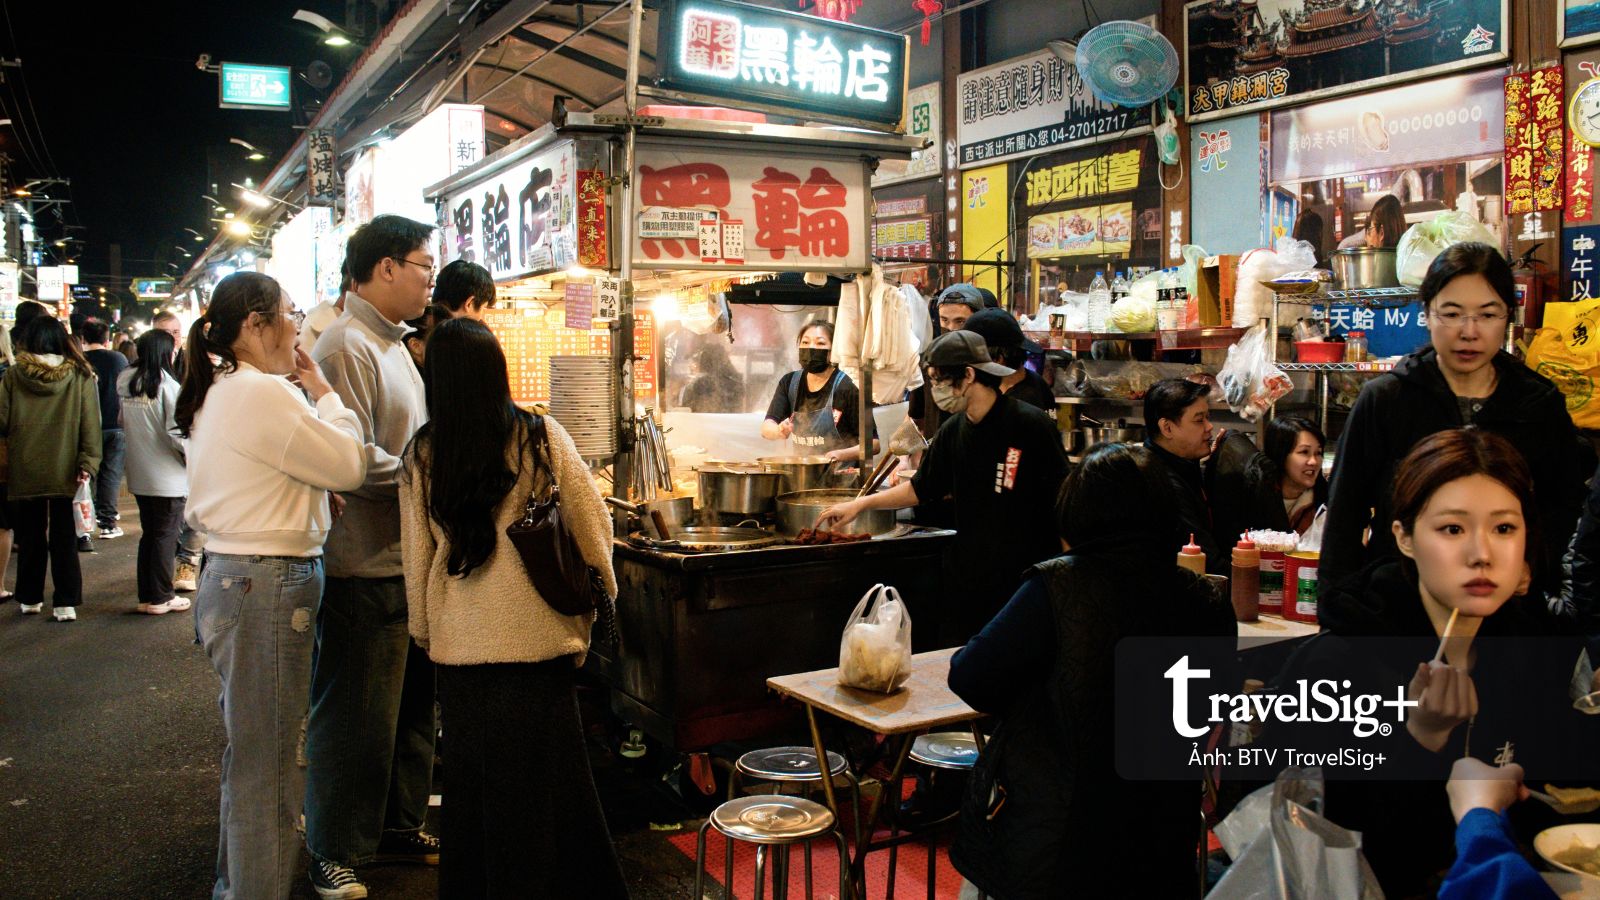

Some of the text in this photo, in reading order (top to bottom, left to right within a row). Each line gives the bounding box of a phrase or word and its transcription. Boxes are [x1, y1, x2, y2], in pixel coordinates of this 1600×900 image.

[741, 24, 893, 103] 黑輪店
[1193, 68, 1290, 112] 大甲鎮瀾宮
[965, 113, 1128, 162] 西屯派出所關心您 04-27012717
[638, 162, 850, 260] 黑輪
[661, 210, 704, 221] 不主動提供
[38, 279, 62, 288] PURE
[1385, 308, 1410, 328] My
[1416, 312, 1428, 327] g
[1571, 322, 1588, 347] 勇
